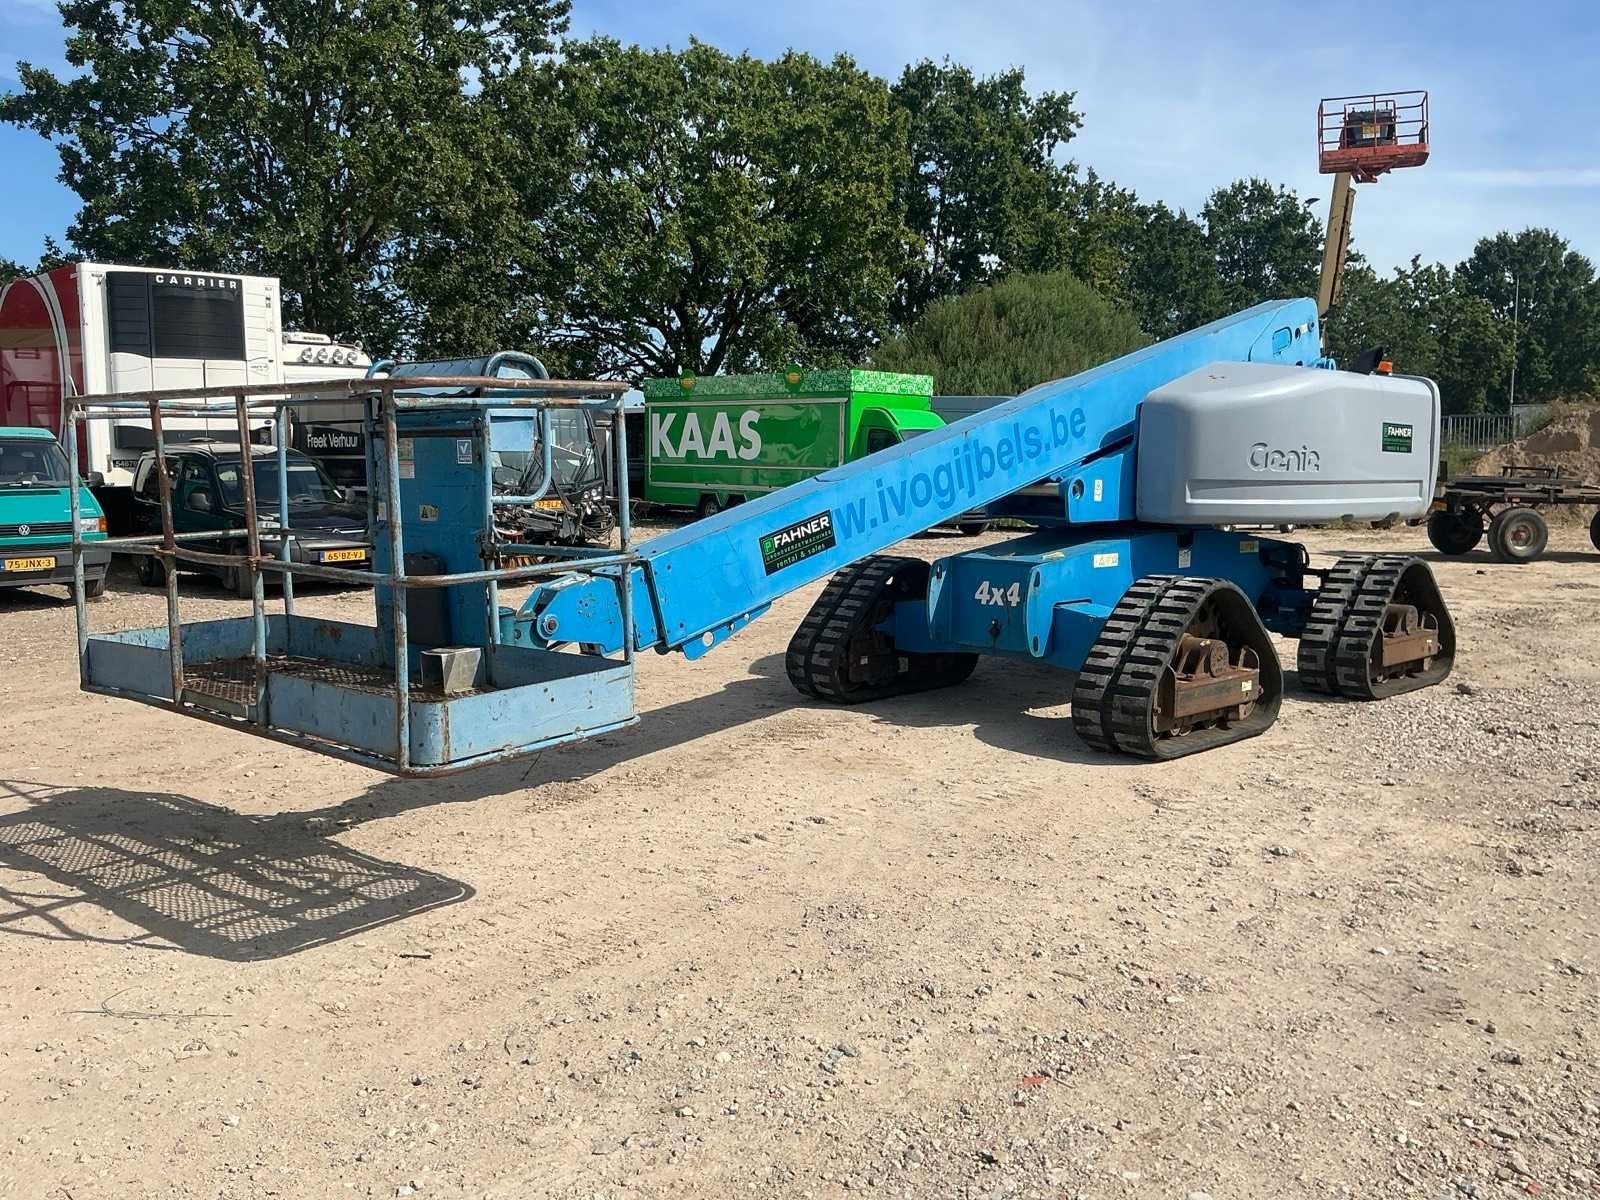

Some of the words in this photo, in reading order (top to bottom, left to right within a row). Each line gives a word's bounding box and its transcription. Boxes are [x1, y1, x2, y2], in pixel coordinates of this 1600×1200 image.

[155, 274, 237, 289] CARRIER
[307, 433, 328, 448] Freek
[328, 432, 358, 448] Verhuur
[651, 409, 762, 460] KAAS
[1387, 426, 1412, 438] FAHNER
[1248, 441, 1320, 472] Genie
[773, 515, 830, 549] FAHNER
[776, 553, 798, 569] rental
[807, 543, 826, 556] sales
[974, 580, 1021, 607] 4x4
